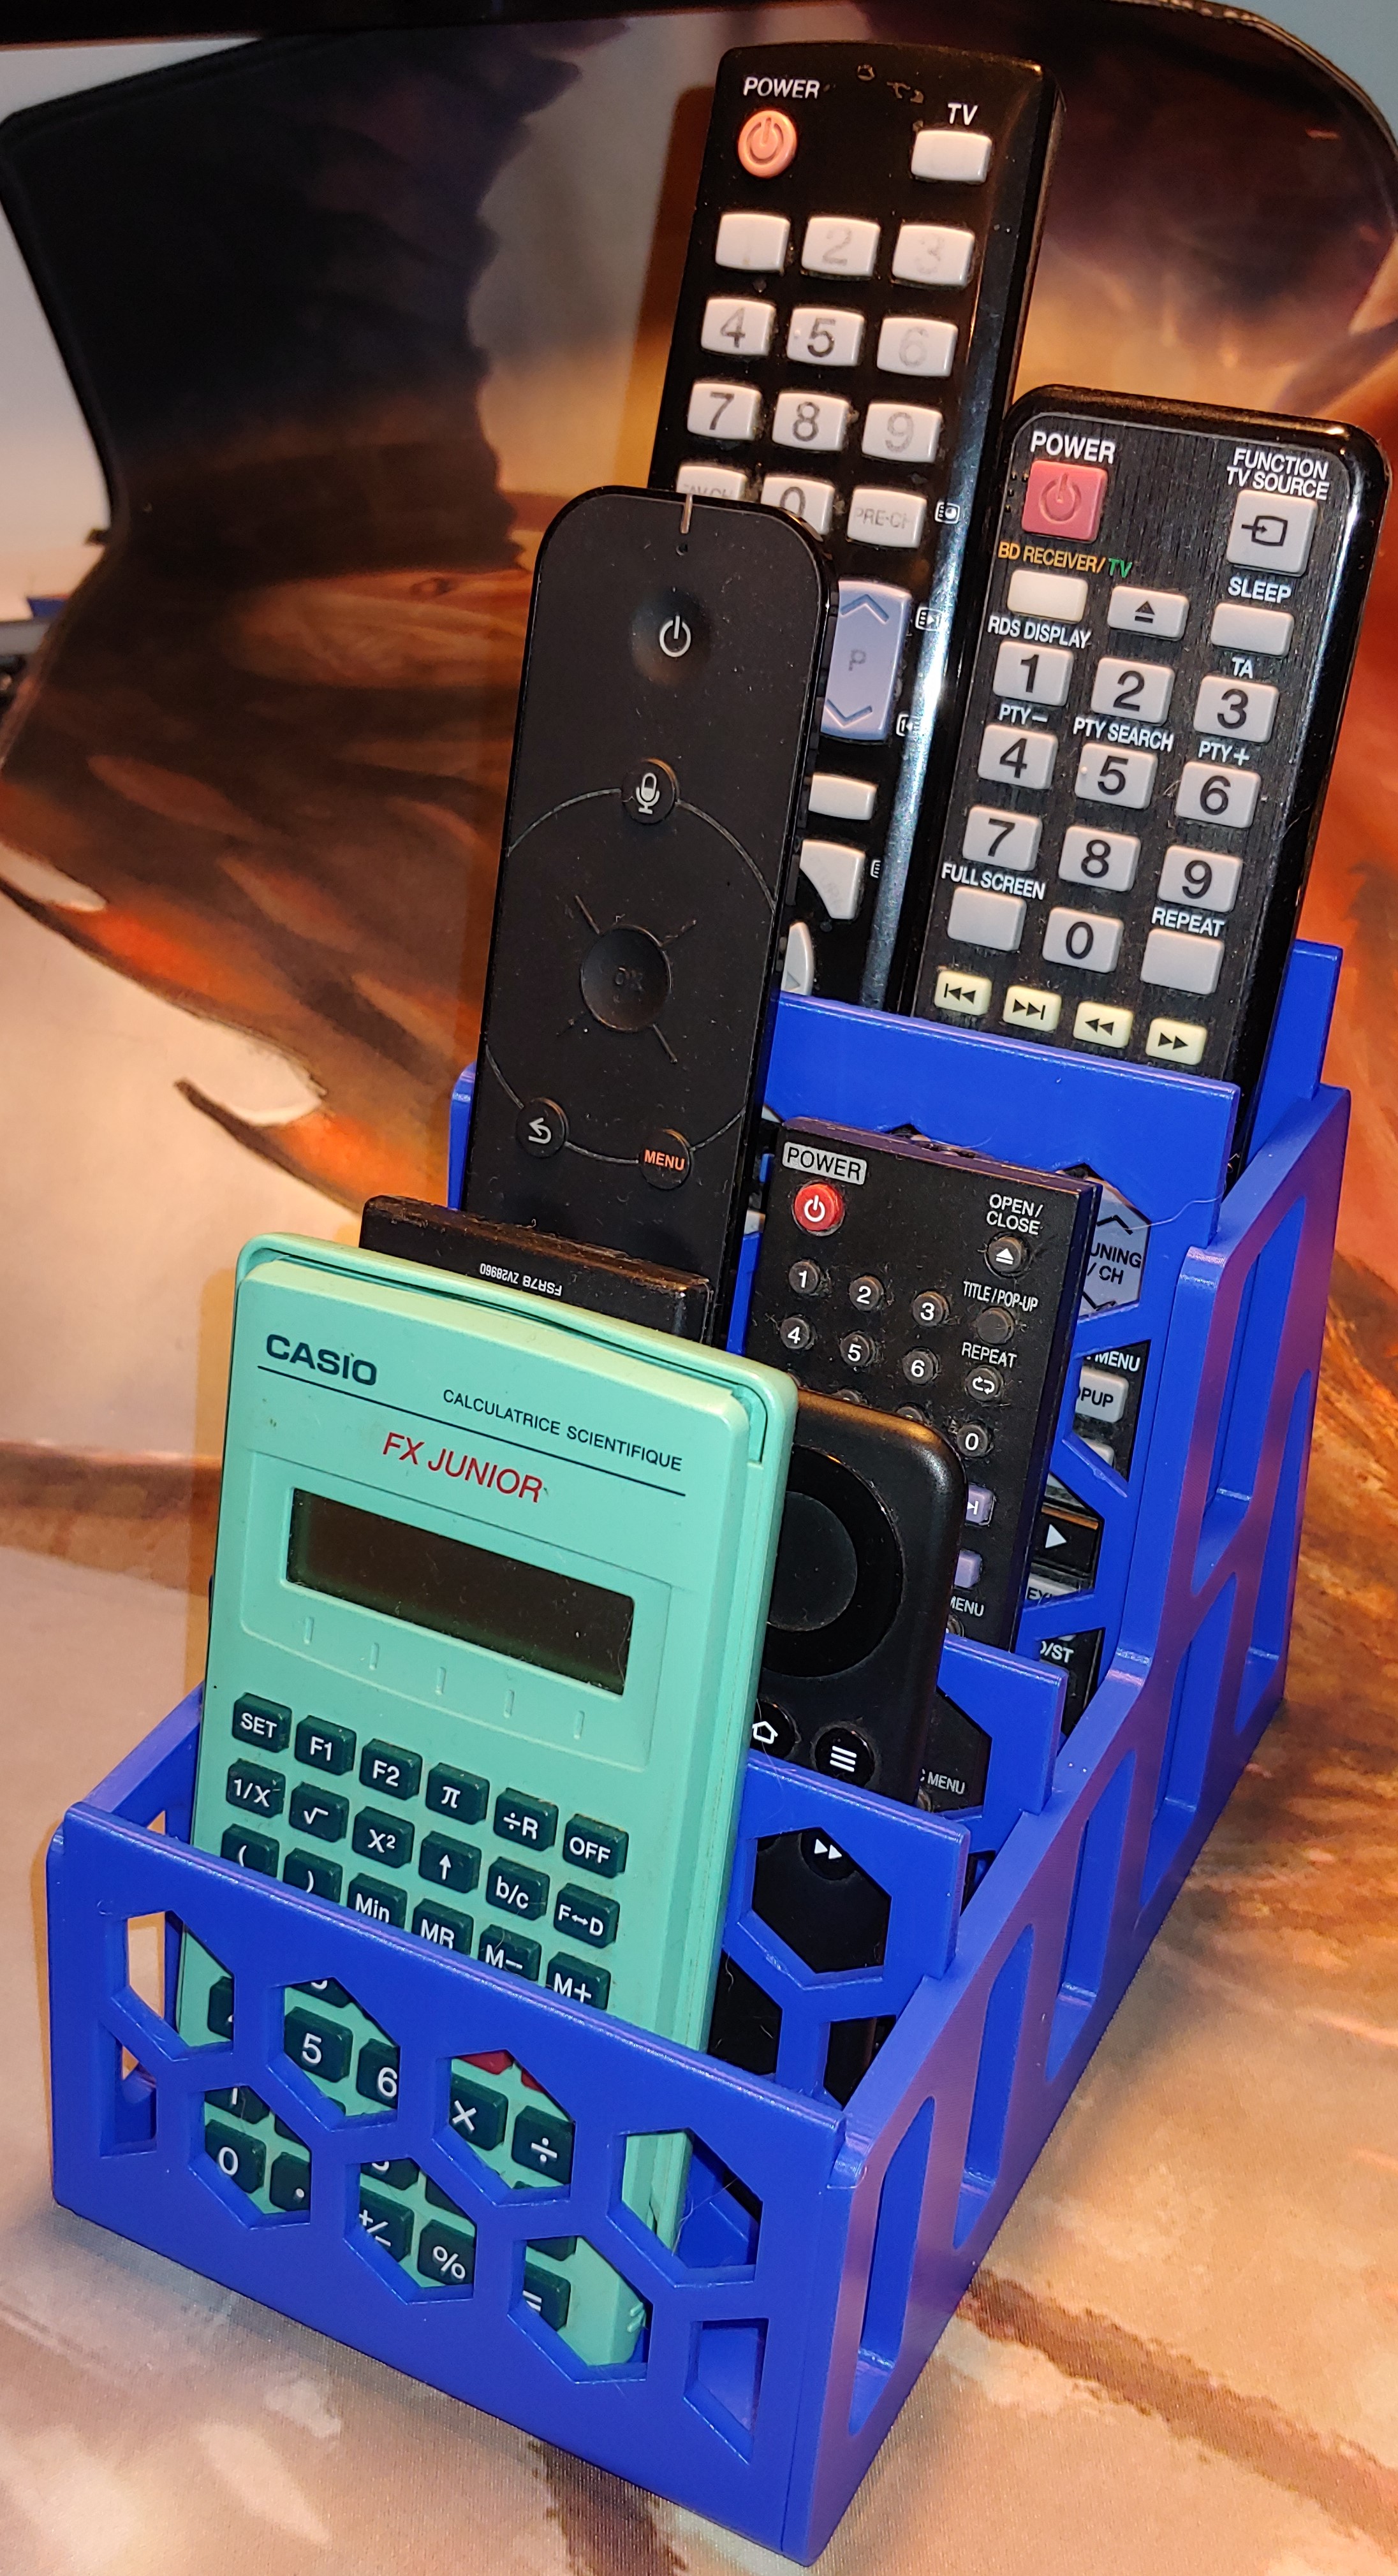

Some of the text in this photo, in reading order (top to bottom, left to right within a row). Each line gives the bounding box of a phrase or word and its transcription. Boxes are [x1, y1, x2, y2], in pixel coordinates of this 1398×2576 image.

[743, 77, 821, 99] POWER
[947, 103, 978, 126] TV
[821, 225, 853, 266] 2
[914, 234, 946, 274] 3
[719, 307, 746, 348] 4
[807, 318, 835, 358] 5
[899, 327, 929, 367] 6
[709, 392, 735, 430] 7
[792, 402, 820, 442] 8
[885, 411, 915, 453] 9
[1030, 430, 1116, 465] POWER
[1233, 447, 1330, 481] FUNCTION
[1226, 467, 1330, 501] TV SOURCE
[998, 541, 1020, 560] BD
[1108, 557, 1133, 578] TV
[1228, 576, 1292, 603] SLEEP
[987, 615, 1091, 649] RDS DISPLAY
[1020, 653, 1040, 694] 1
[1232, 657, 1254, 679] TA
[1112, 670, 1146, 712] 2
[1216, 688, 1249, 730] 3
[1073, 718, 1174, 752] PTY SEARCH
[999, 738, 1027, 779] 4
[1097, 755, 1129, 796] 5
[1199, 775, 1232, 816] 6
[987, 819, 1016, 858] 7
[1080, 838, 1110, 879] 8
[941, 862, 1047, 901] FULL SCREEN
[1181, 859, 1213, 900] 9
[1151, 907, 1225, 937] REPEAT
[1065, 921, 1094, 960] 0
[644, 1148, 686, 1172] MENU
[786, 1147, 862, 1182] POWER
[986, 1211, 1041, 1236] CLOSE
[1090, 1243, 1142, 1268] UNING
[480, 1262, 563, 1297] FSR78 ZV28960
[798, 1270, 808, 1289] 1
[858, 1285, 872, 1304] 2
[920, 1301, 935, 1321] 3
[786, 1326, 801, 1343] 4
[265, 1334, 378, 1386] CASIO
[848, 1343, 862, 1362] 5
[911, 1359, 926, 1378] 6
[961, 1342, 1017, 1368] REPEAT
[443, 1388, 684, 1472] CALCULATRICE SCIENTIFIQUE
[964, 1431, 980, 1452] 0
[383, 1431, 544, 1504] FX JUNIOR
[240, 1712, 277, 1739] SET
[310, 1736, 333, 1762] F1
[372, 1760, 400, 1788] F2
[927, 1771, 966, 1795] MENU
[569, 1836, 611, 1864] OFF
[355, 1893, 391, 1926] Min
[496, 1875, 530, 1910] b/c
[420, 1918, 455, 1950] MR
[302, 2033, 322, 2064] 5
[377, 2067, 397, 2098] 6
[219, 2146, 239, 2176] 0
[433, 2245, 466, 2280] %
